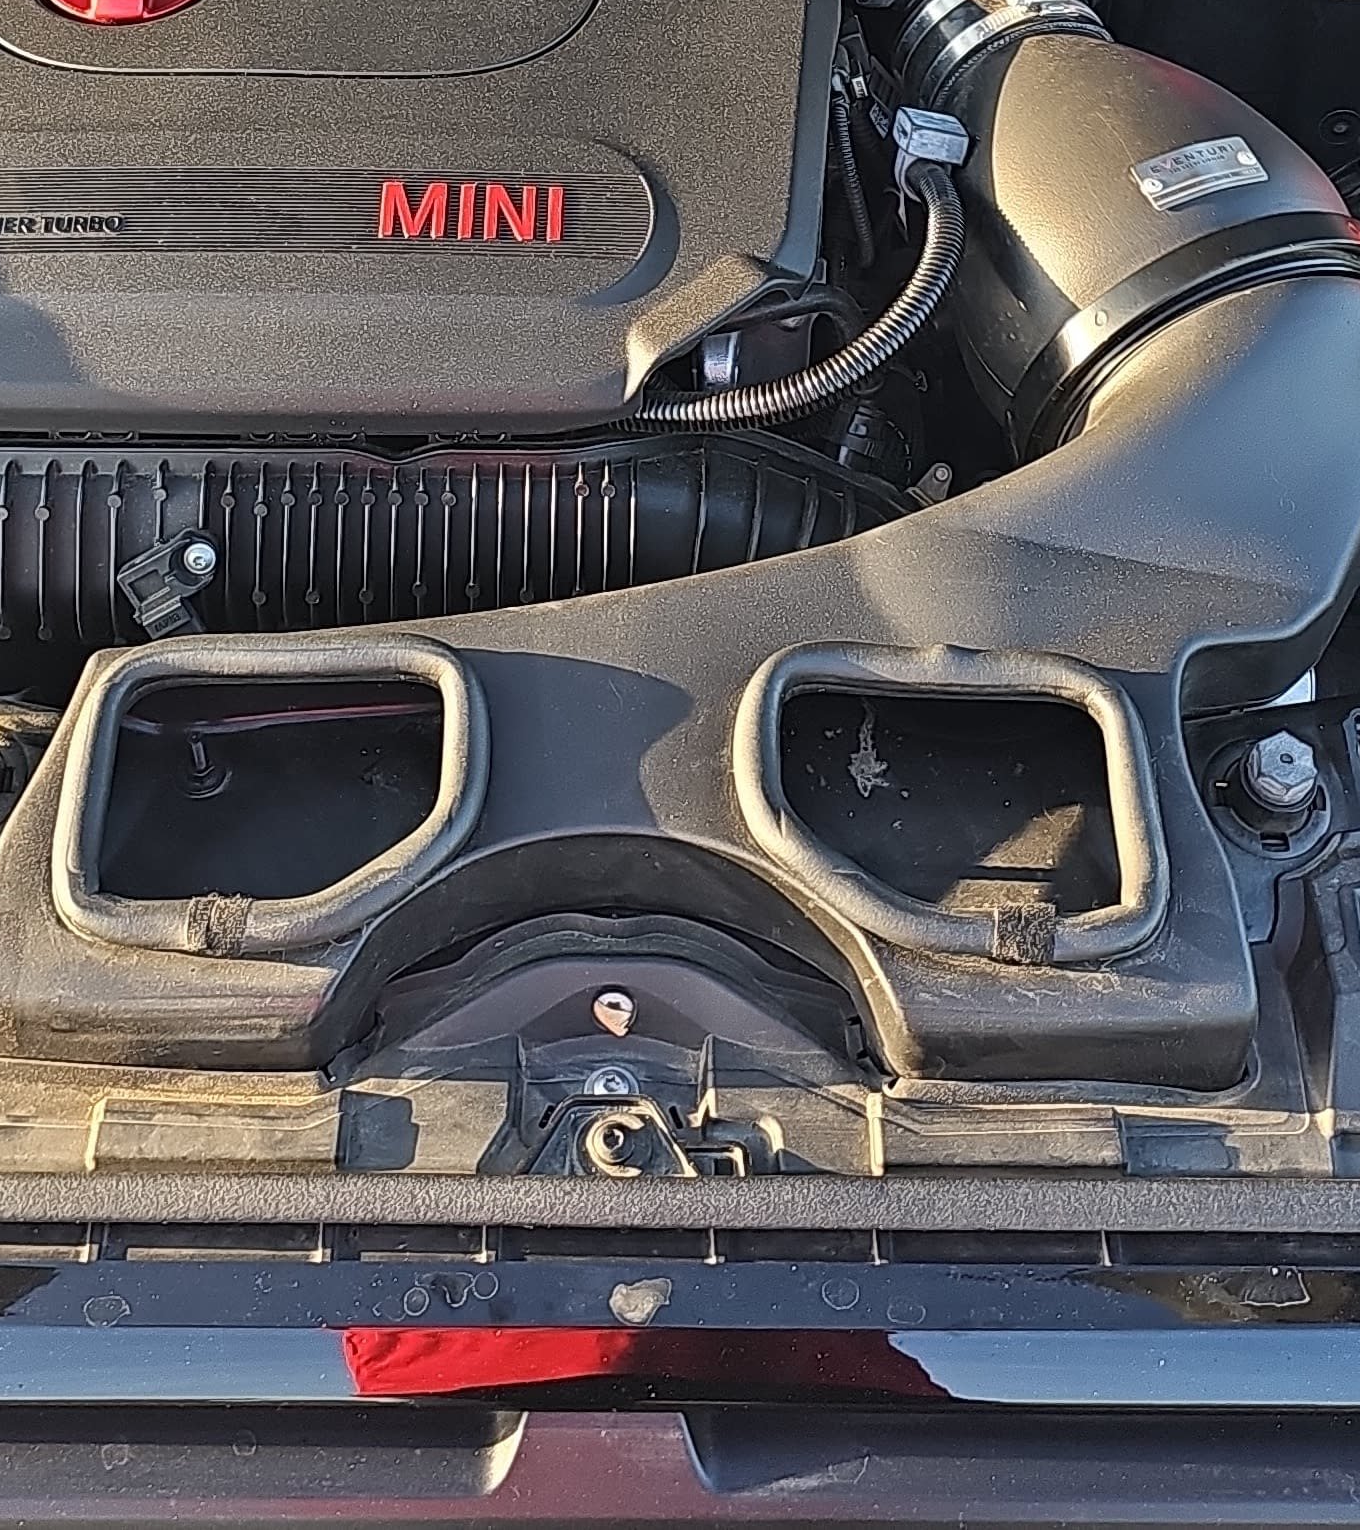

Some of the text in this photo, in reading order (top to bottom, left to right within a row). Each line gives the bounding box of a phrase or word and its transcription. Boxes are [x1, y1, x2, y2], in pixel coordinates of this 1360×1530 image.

[1149, 143, 1235, 174] EVENTURI
[41, 215, 125, 234] TURBO
[378, 180, 566, 243] MINI
